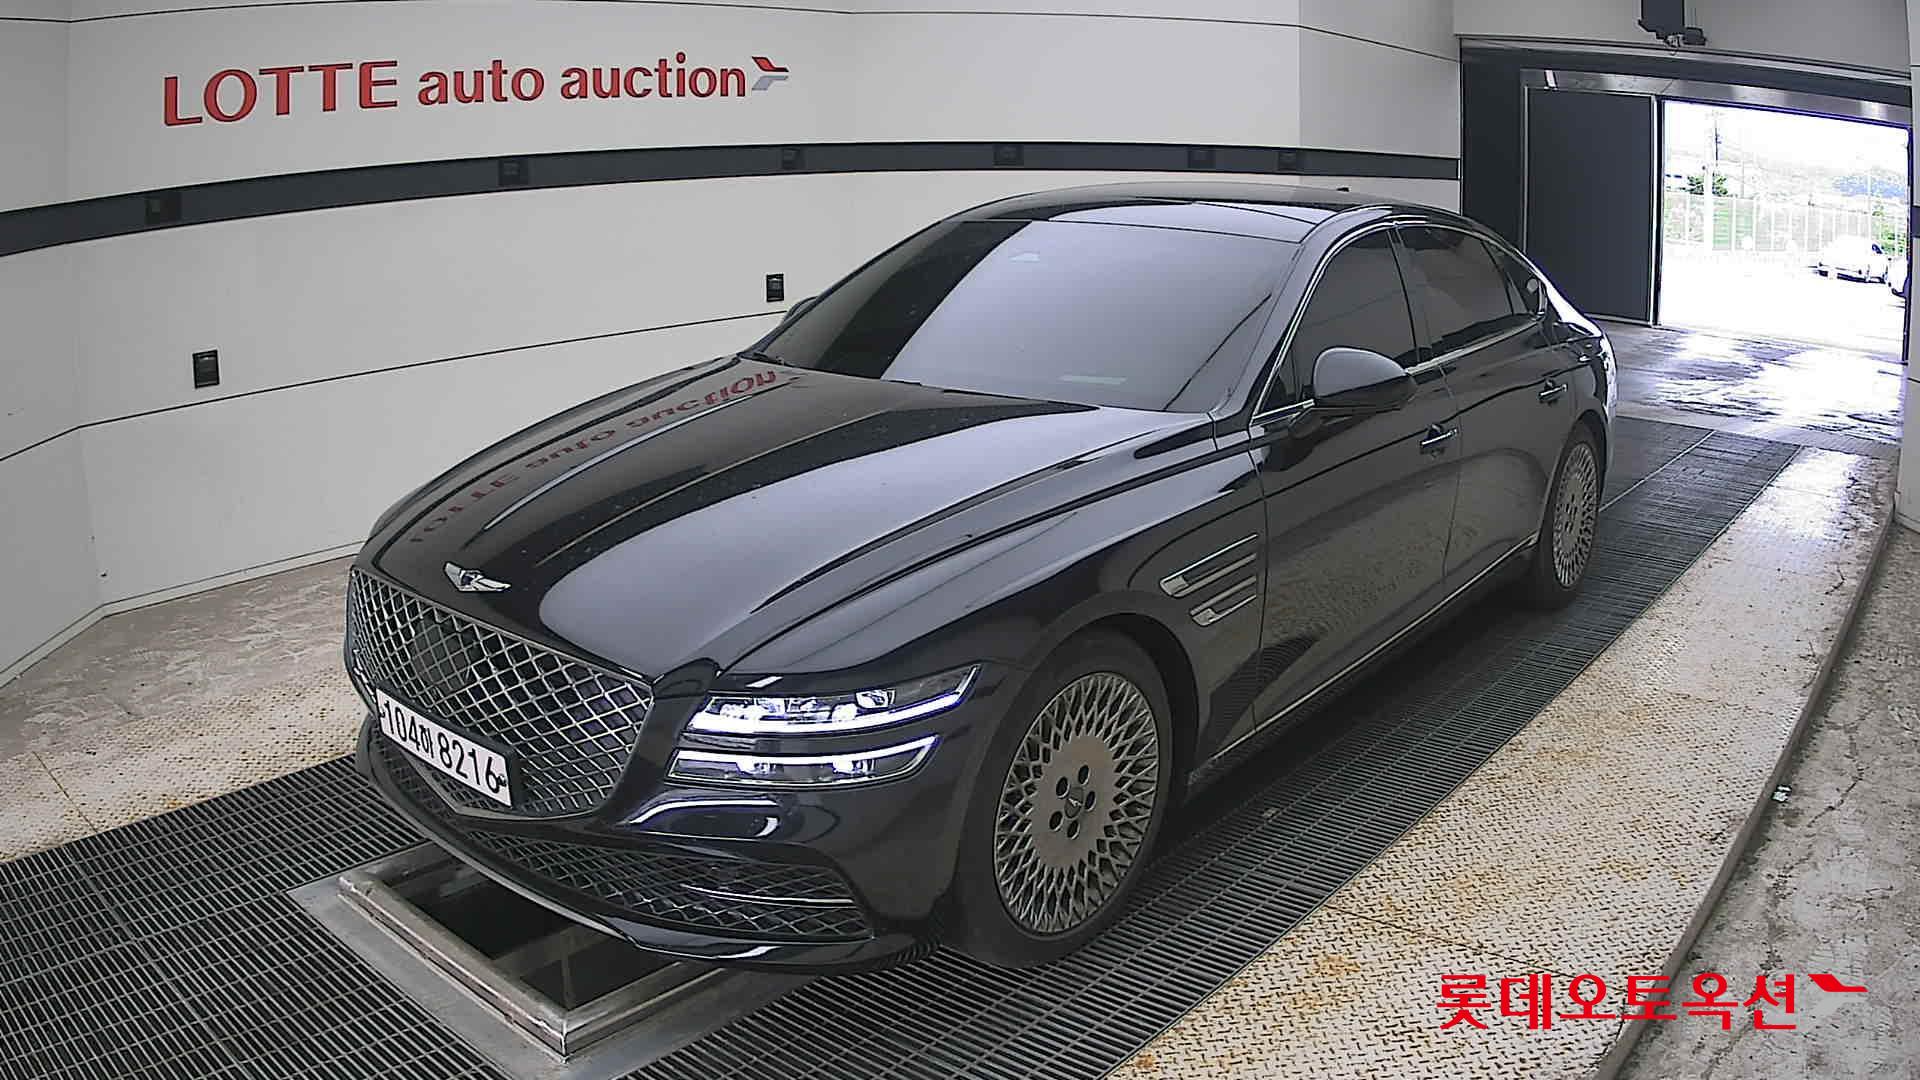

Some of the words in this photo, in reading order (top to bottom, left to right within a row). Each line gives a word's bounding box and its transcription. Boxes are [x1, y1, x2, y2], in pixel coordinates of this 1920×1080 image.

[164, 60, 398, 126] LOTTE
[417, 59, 545, 106] auto
[560, 52, 746, 99] auction
[437, 731, 501, 794] 8216
